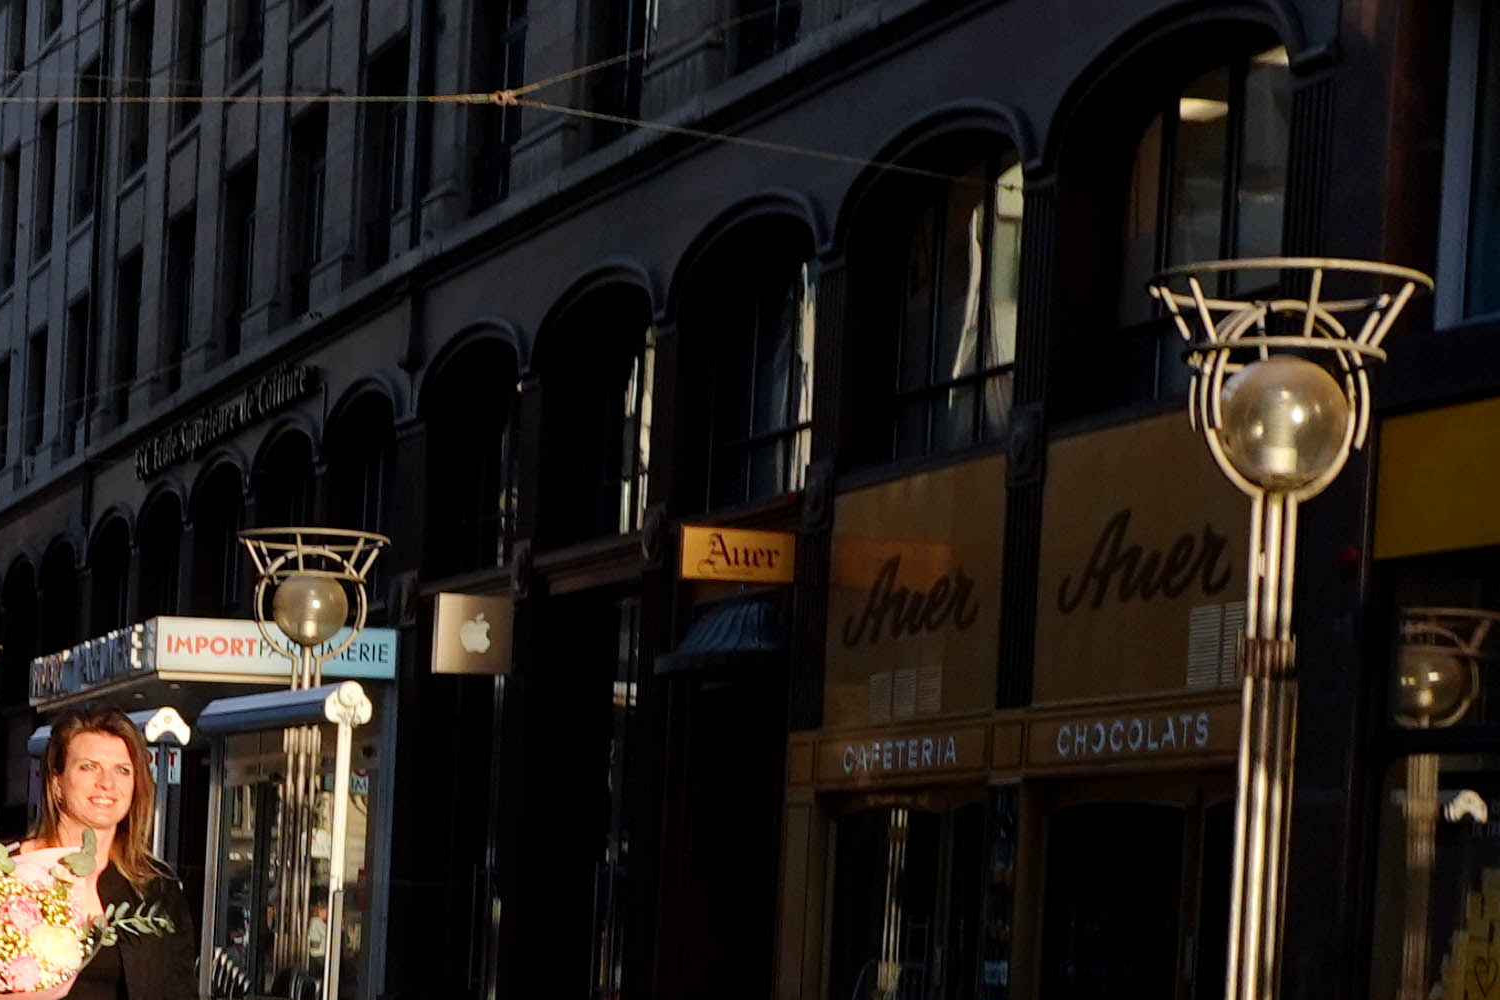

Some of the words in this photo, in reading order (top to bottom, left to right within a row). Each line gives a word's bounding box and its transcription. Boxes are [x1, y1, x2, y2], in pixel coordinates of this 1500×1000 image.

[698, 532, 781, 574] Auer
[1058, 508, 1232, 613] Auer
[843, 554, 979, 646] Auer
[843, 736, 958, 773] CAFETERIA
[1056, 711, 1210, 757] CHOCOLATS
